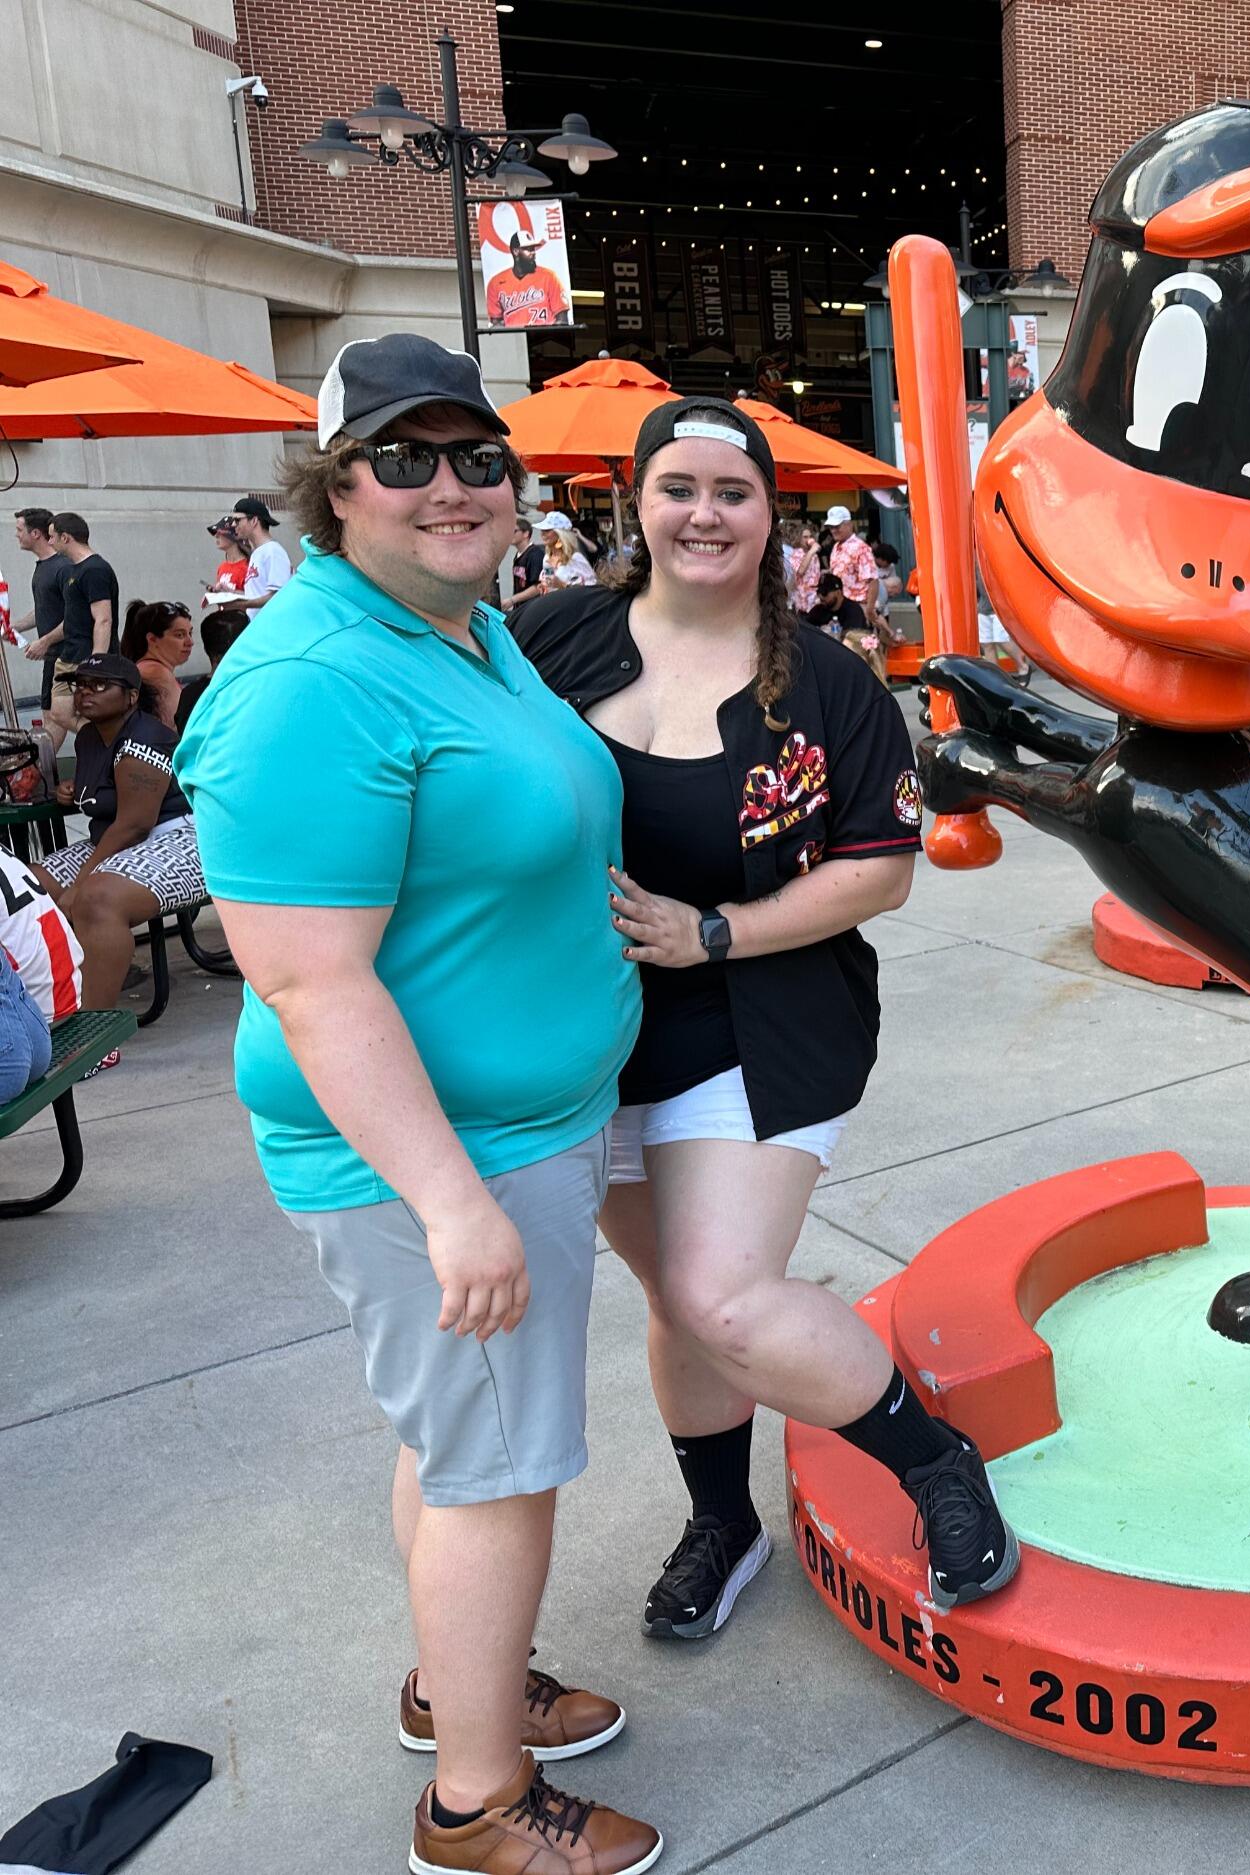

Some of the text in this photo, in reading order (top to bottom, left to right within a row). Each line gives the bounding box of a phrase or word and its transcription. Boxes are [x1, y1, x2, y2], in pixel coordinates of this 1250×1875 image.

[613, 262, 643, 330] BEER
[702, 264, 725, 336] PEANUTS
[770, 269, 789, 299] HOT
[528, 308, 547, 326] 74
[772, 302, 792, 341] DOGS
[805, 1524, 960, 1683] ORIOLES
[1029, 1670, 1218, 1752] 2002
